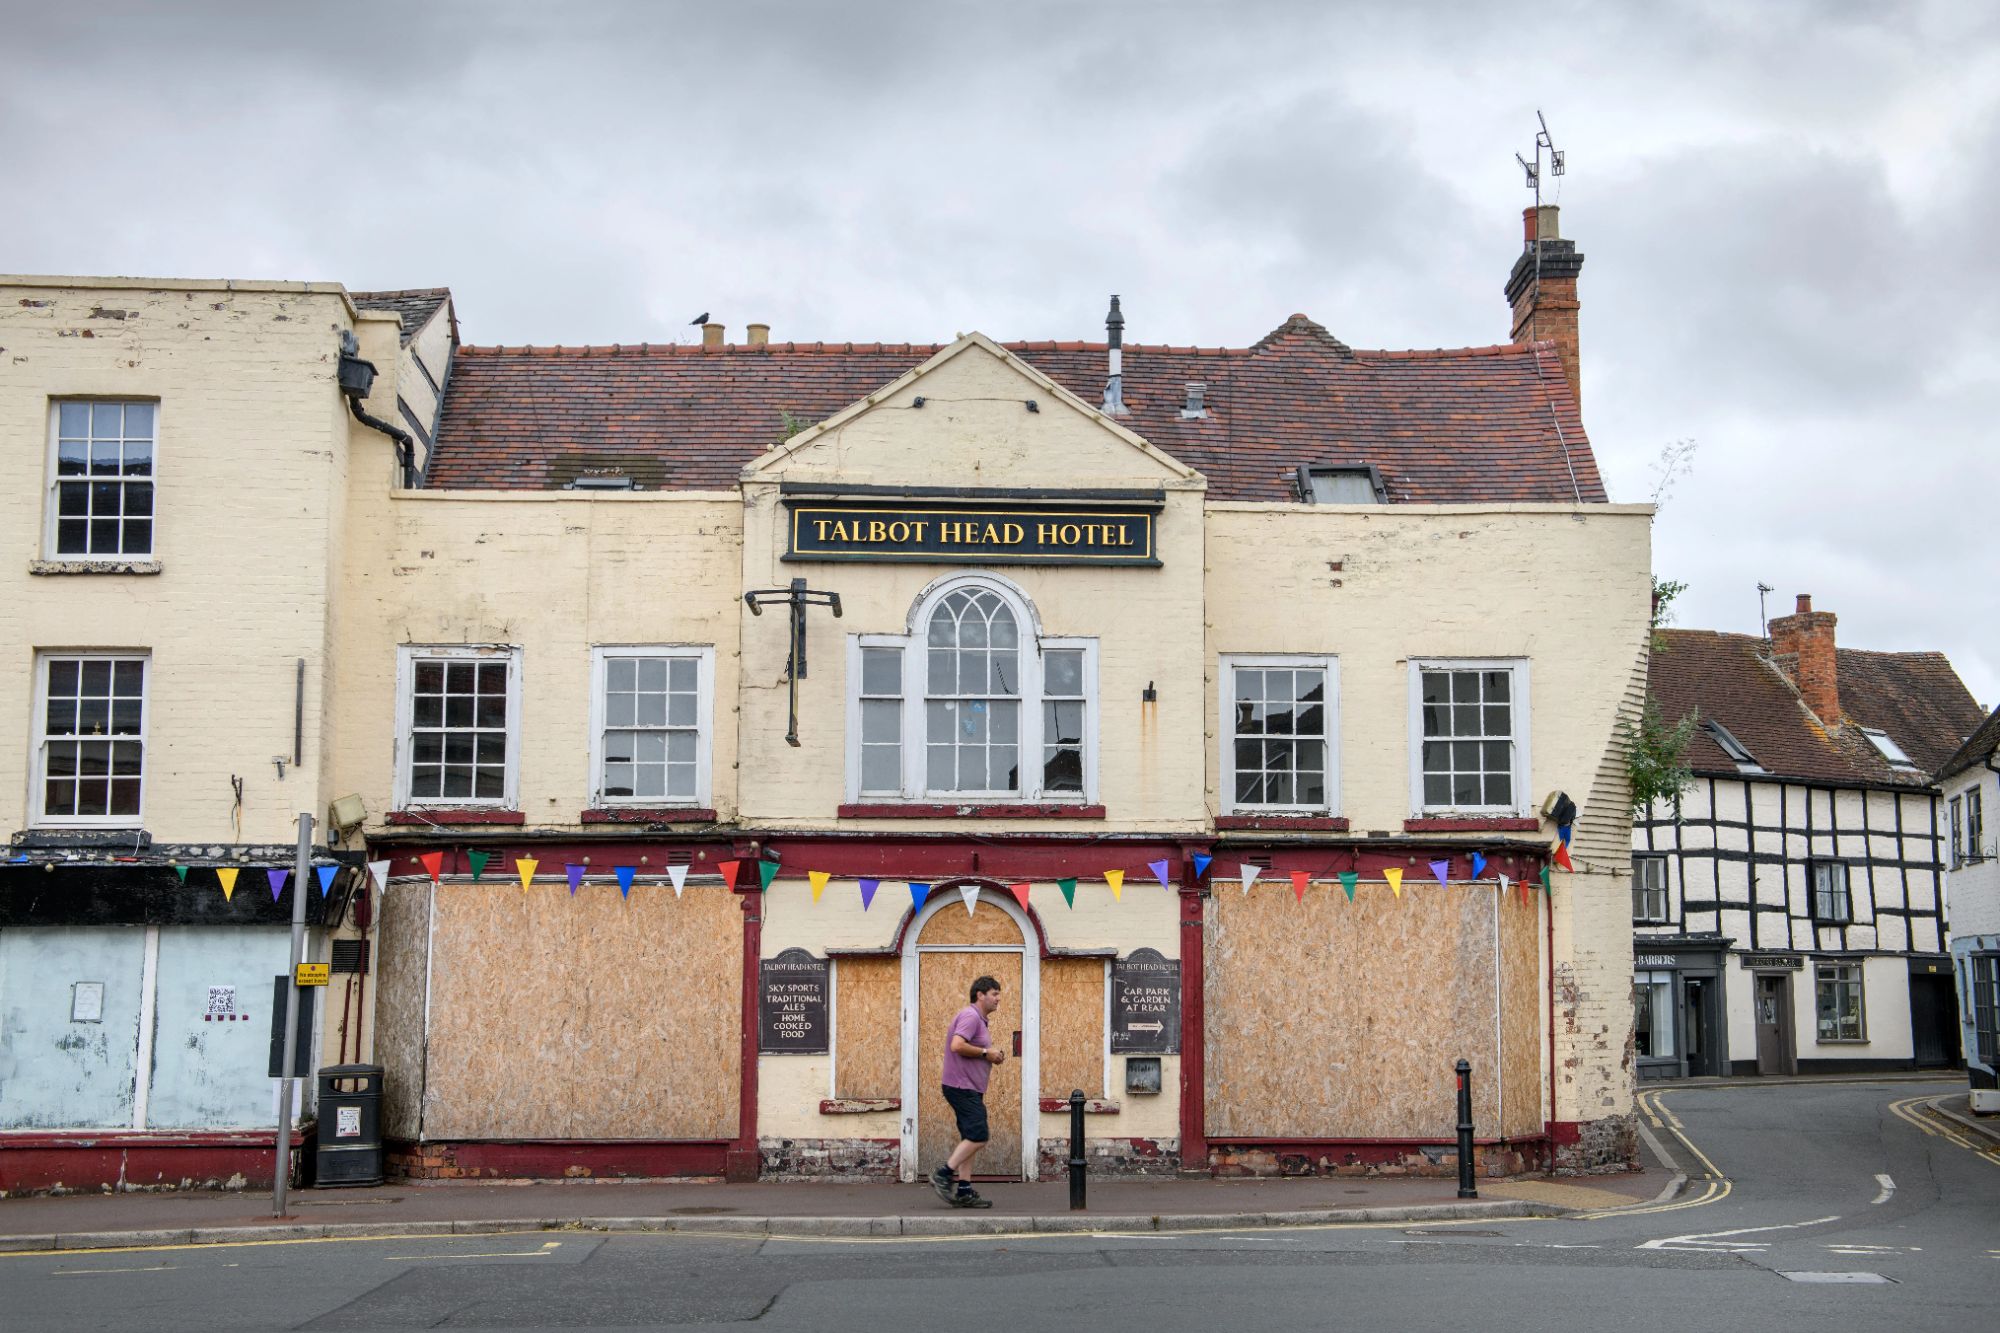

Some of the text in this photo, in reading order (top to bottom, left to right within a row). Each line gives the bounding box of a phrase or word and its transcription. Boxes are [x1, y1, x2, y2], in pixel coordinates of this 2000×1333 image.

[813, 520, 1134, 546] TALBOT HEAD HOTEL
[1638, 954, 1676, 966] BARBERS
[764, 963, 786, 971] TALBOT
[1140, 963, 1159, 971] HEAD
[768, 984, 820, 993] SKY SPORTS
[1123, 987, 1170, 995] CAR PARK
[766, 995, 822, 1003] TRADITIONAL
[1120, 995, 1171, 1004] & GARDEN
[782, 1003, 806, 1011] ALES
[1126, 1004, 1167, 1012] AT REAR
[781, 1014, 806, 1022] HOME
[773, 1022, 812, 1030] COOKED
[781, 1030, 805, 1038] FOOD
